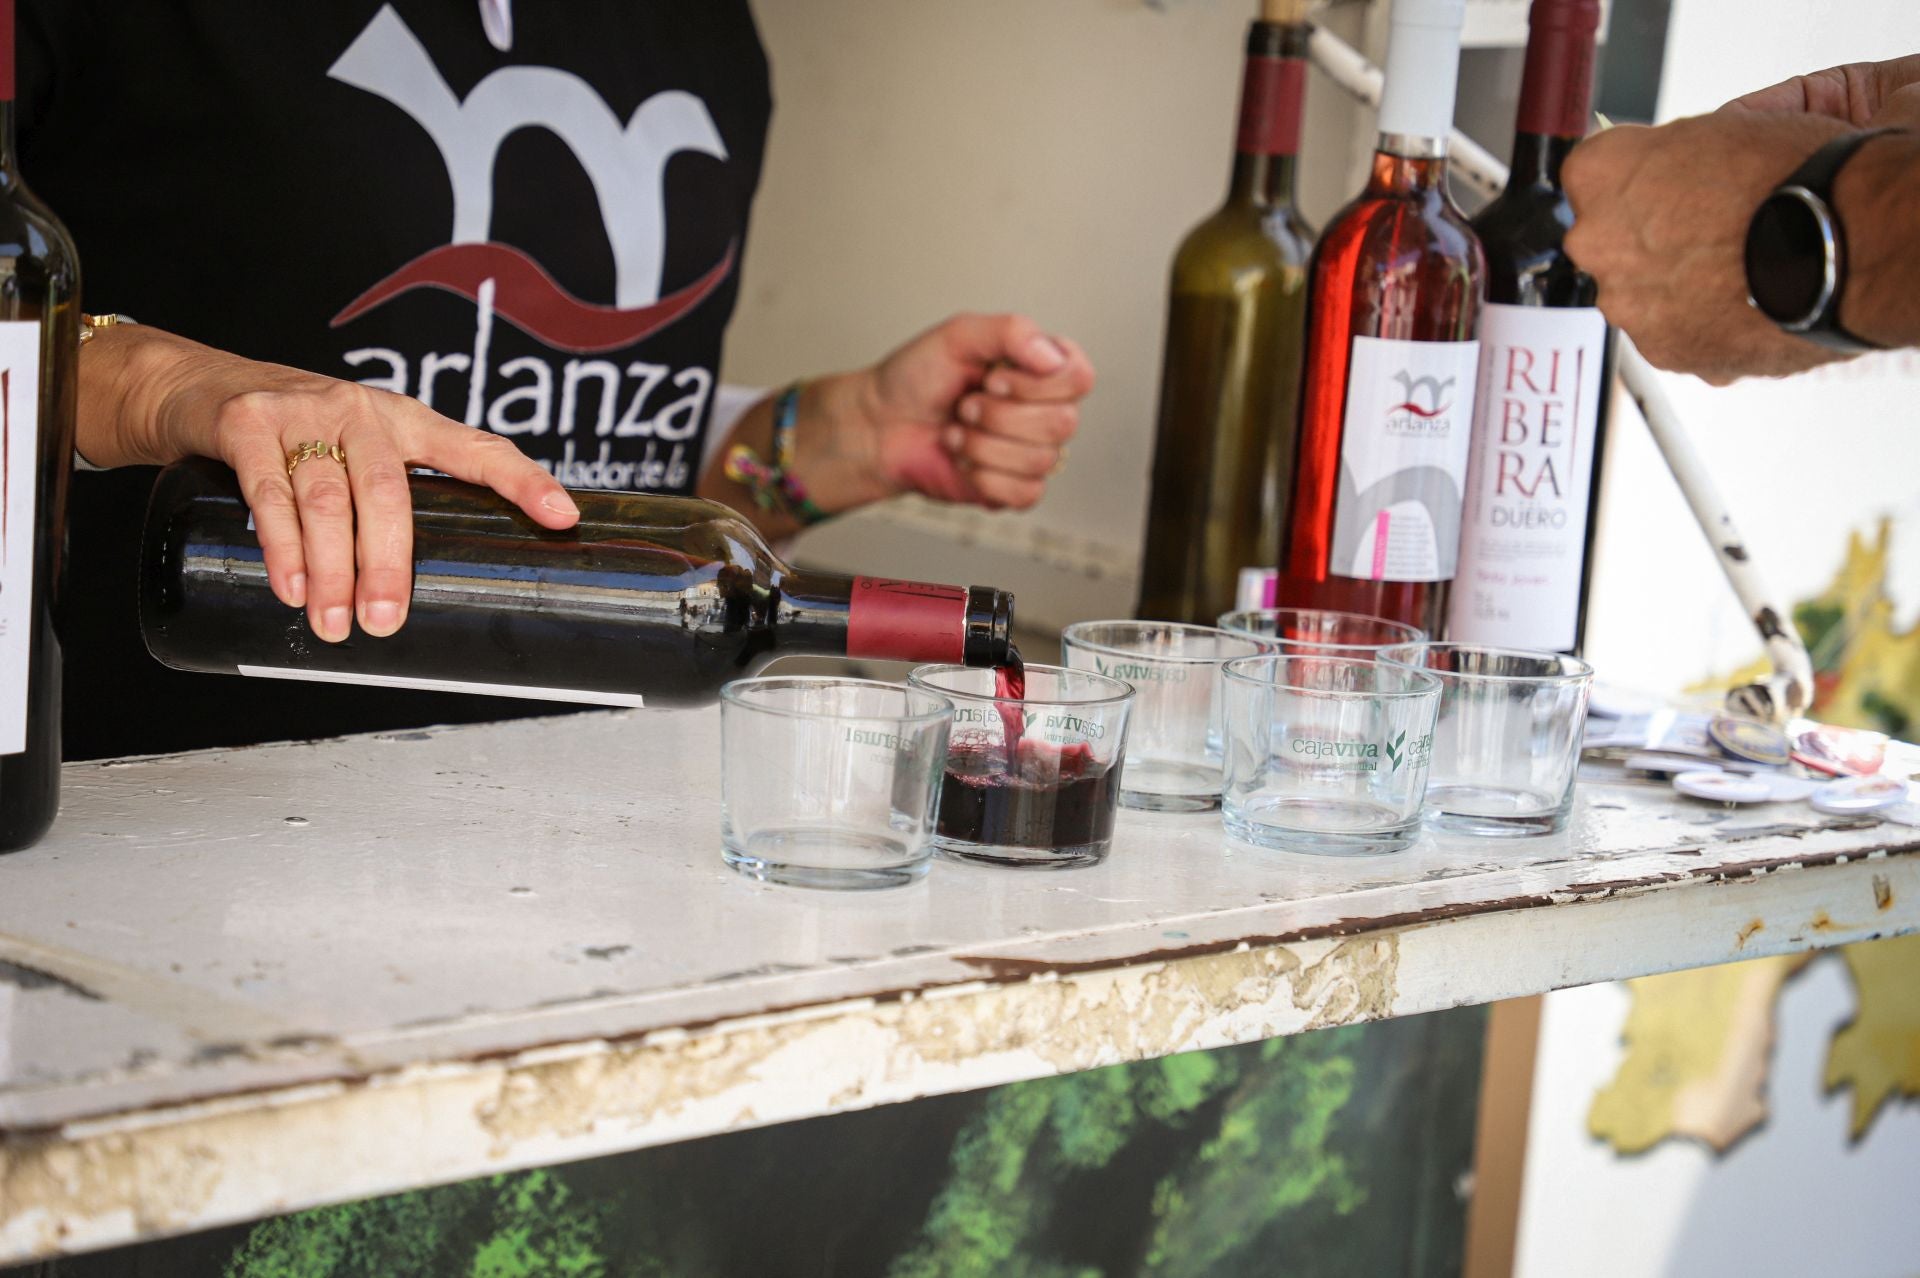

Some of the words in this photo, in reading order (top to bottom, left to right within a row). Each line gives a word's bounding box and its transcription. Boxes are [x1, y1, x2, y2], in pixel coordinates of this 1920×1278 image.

[343, 279, 713, 440] arlanza
[1490, 505, 1568, 530] DUERO
[1292, 736, 1379, 759] cajaviva
